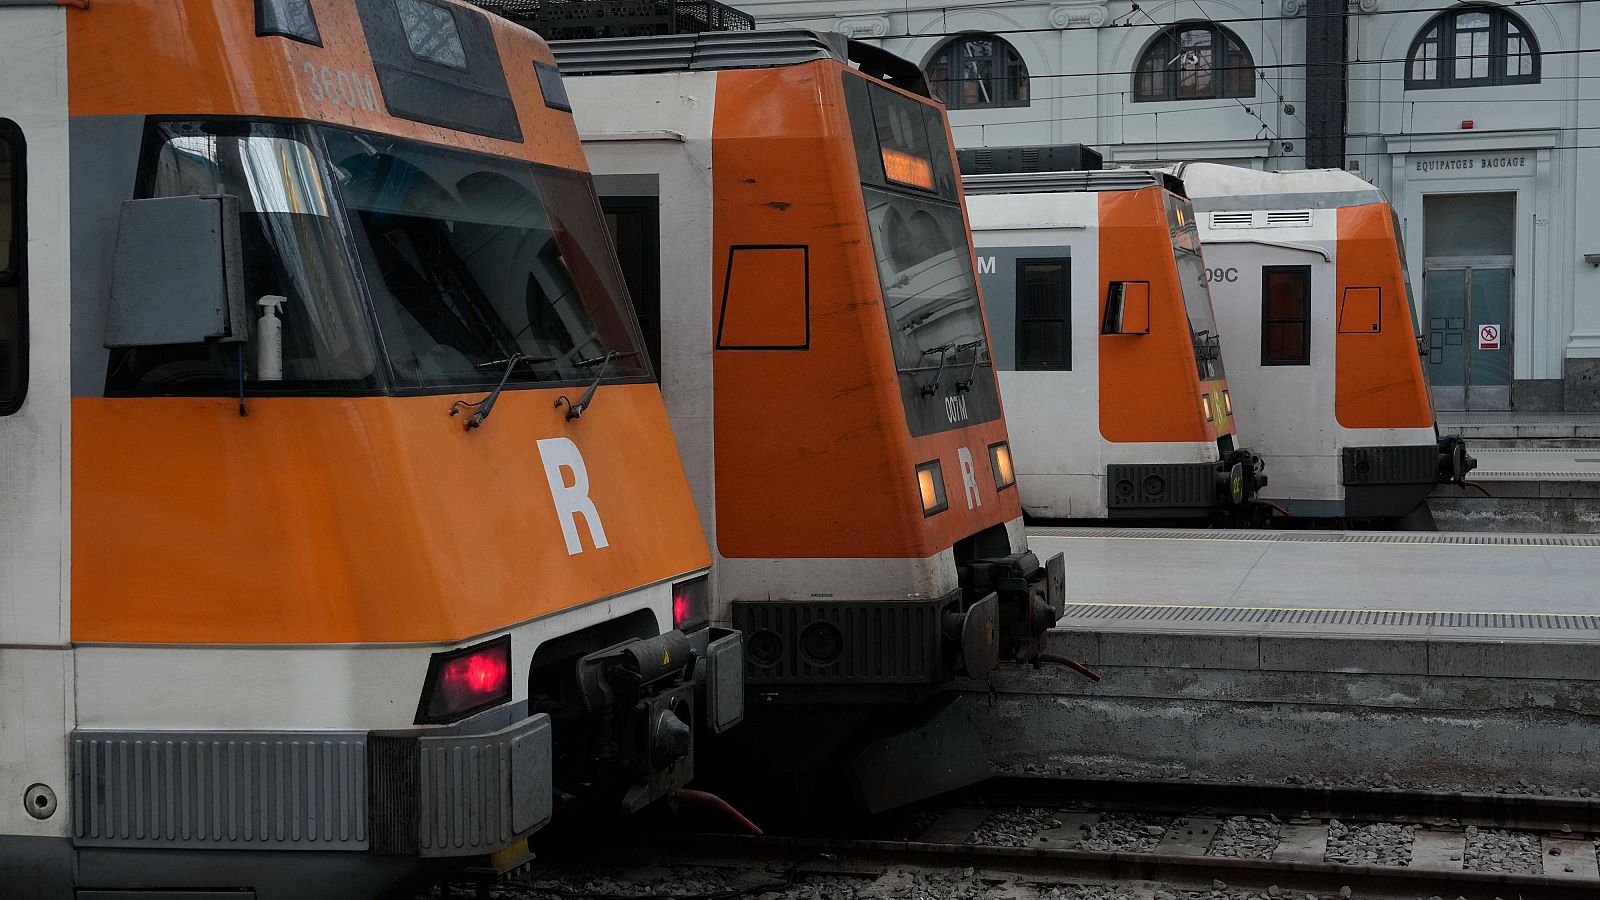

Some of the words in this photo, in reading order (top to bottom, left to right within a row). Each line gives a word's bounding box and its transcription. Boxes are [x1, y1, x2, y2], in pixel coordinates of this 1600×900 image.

[303, 62, 381, 112] 360M
[1416, 159, 1474, 172] EQUIPATGES
[1481, 157, 1525, 168] BAGGAGE
[977, 256, 996, 273] M
[944, 394, 968, 423] 007M
[536, 437, 610, 556] R
[957, 447, 981, 510] R
